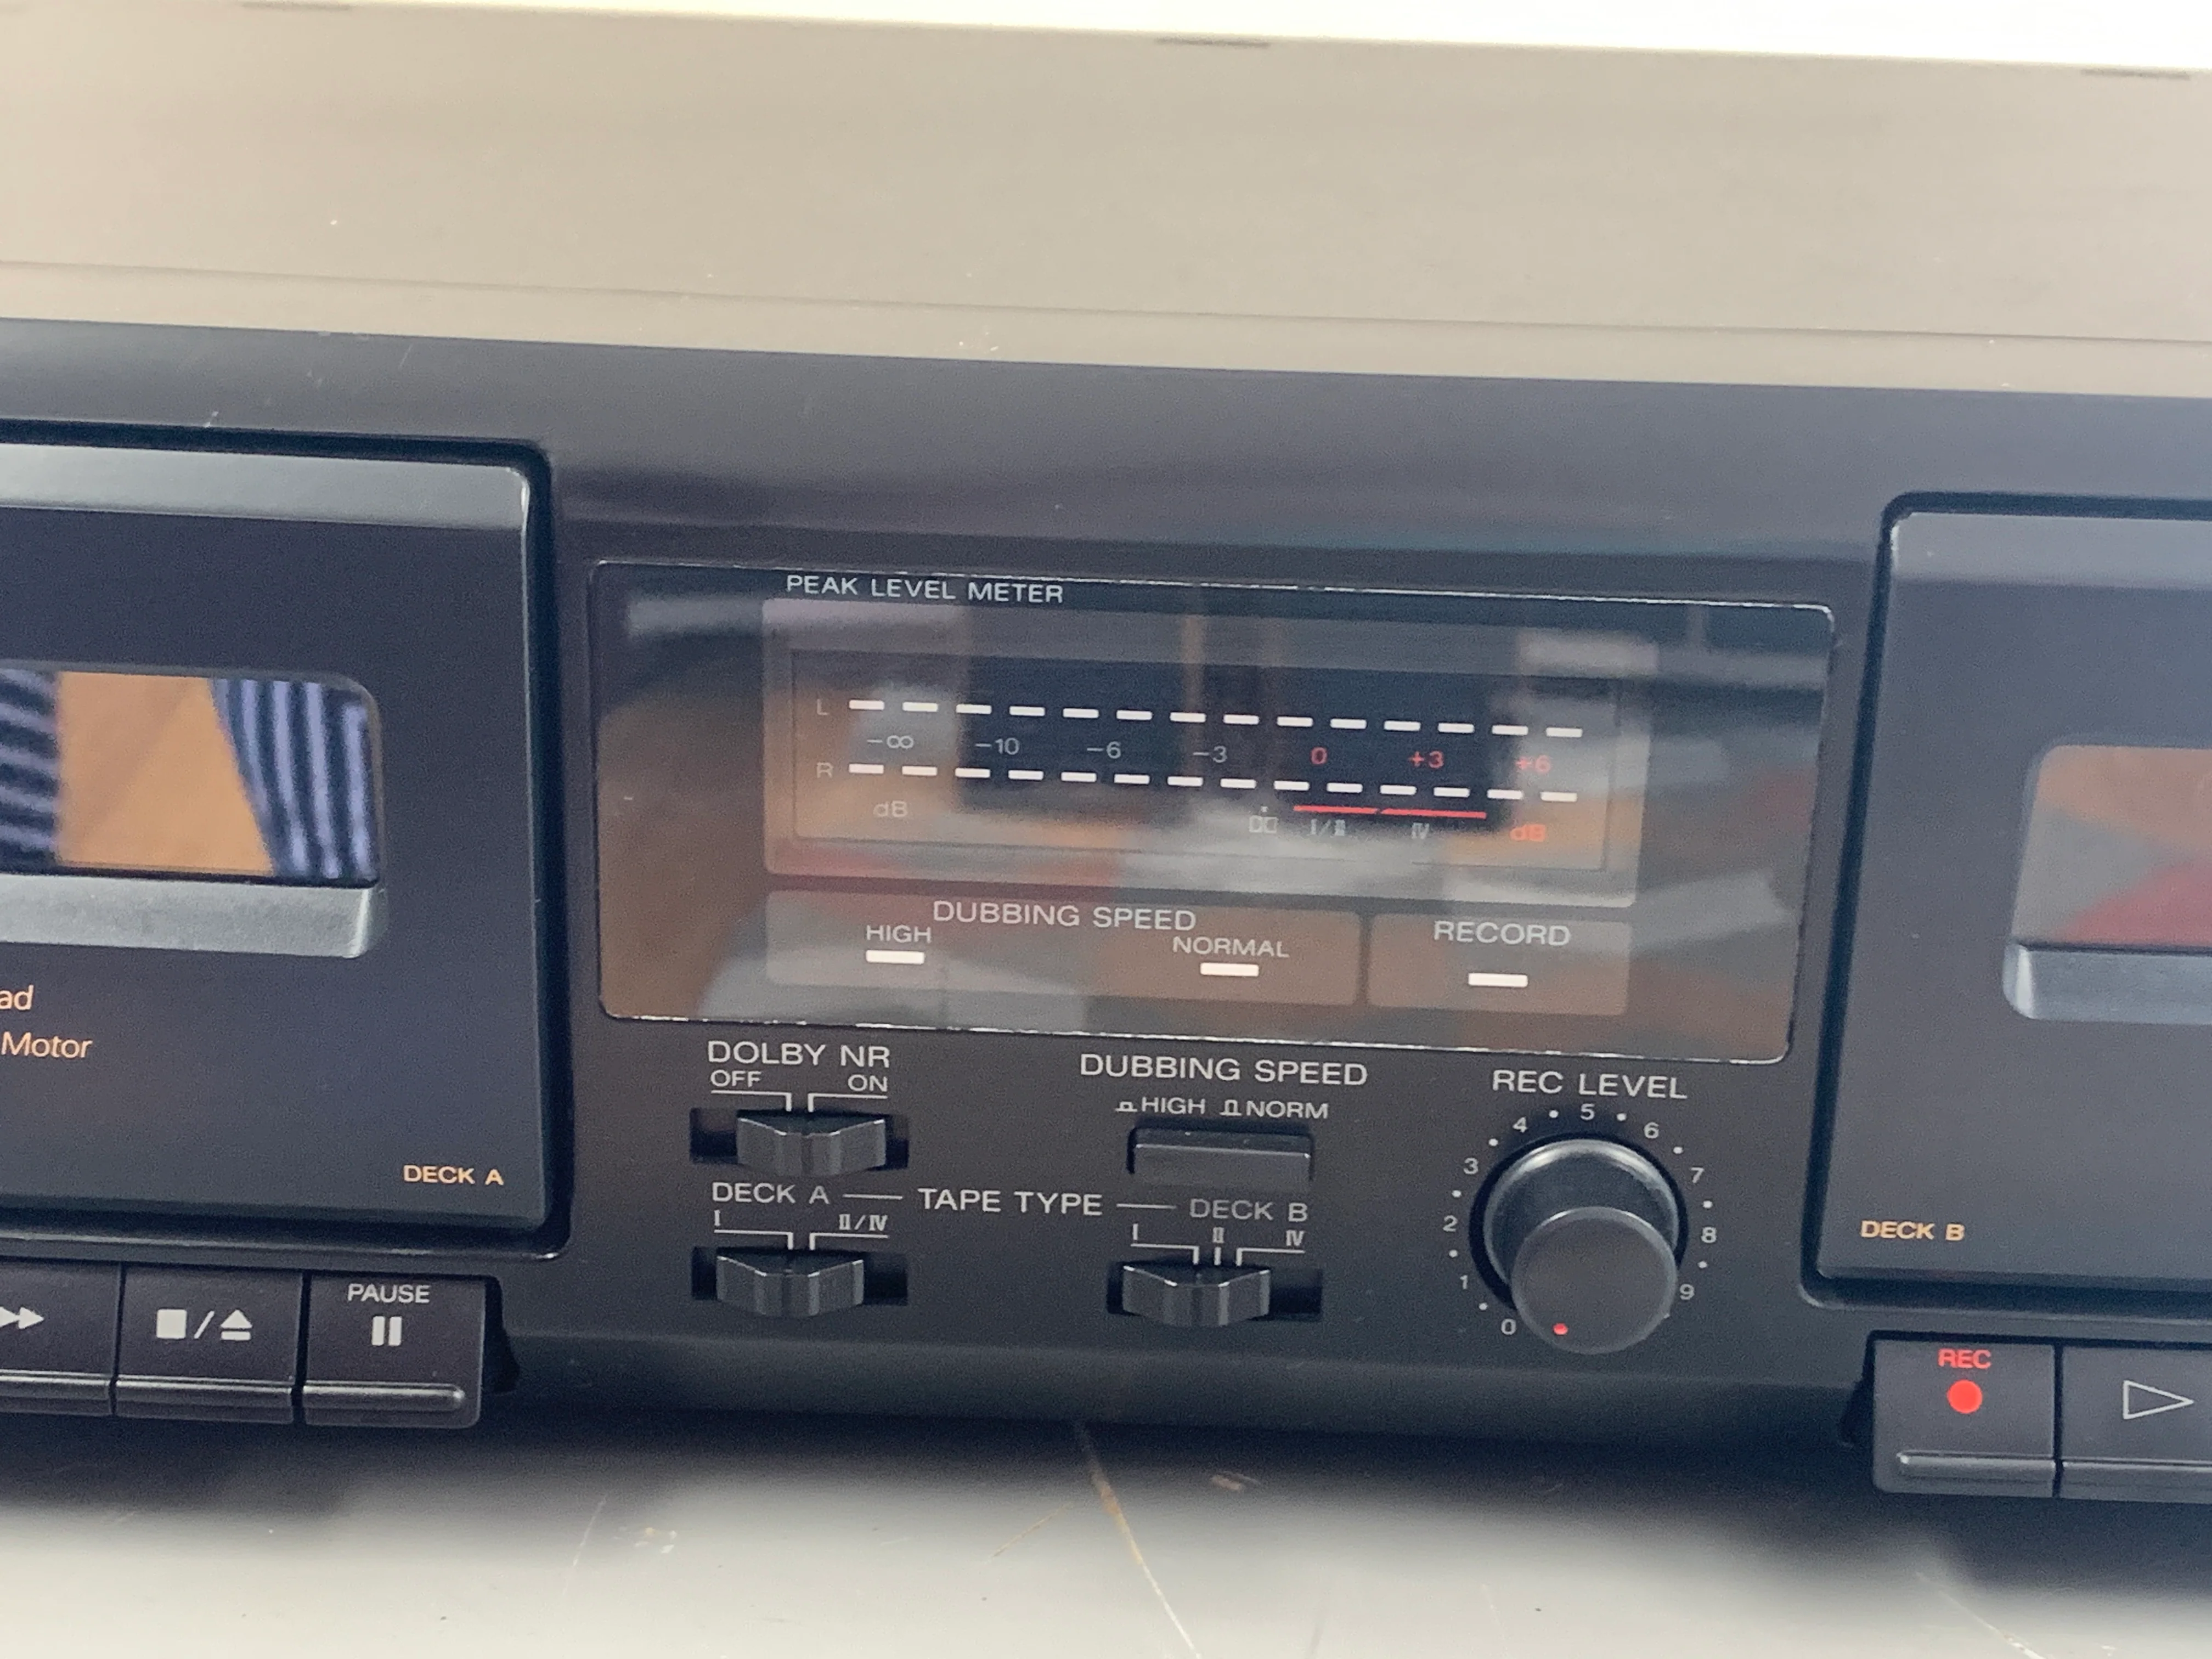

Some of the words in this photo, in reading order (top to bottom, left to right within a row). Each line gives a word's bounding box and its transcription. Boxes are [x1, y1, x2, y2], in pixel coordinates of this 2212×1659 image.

[786, 574, 858, 596] PEAK
[871, 579, 956, 600] LEVEL
[968, 582, 1064, 603] METER
[816, 699, 829, 716] L
[975, 737, 1021, 755] -10
[1087, 741, 1122, 759] -6
[1193, 746, 1228, 764] -3
[1311, 747, 1328, 764] 0
[1410, 751, 1444, 769] +3
[1515, 755, 1552, 774] +6
[816, 763, 833, 778] R
[873, 801, 909, 819] dB
[1510, 824, 1546, 842] dB
[933, 900, 1080, 927] DUBBING
[1092, 907, 1197, 931] SPEED
[866, 924, 932, 943] HIGH
[1434, 921, 1572, 946] RECORD
[1172, 936, 1290, 958] NORMAL
[1, 1031, 93, 1059] Motor
[707, 1040, 826, 1065] DOLBY
[840, 1045, 890, 1068] NR
[710, 1069, 762, 1087] OFF
[1080, 1053, 1240, 1081] DUBBING
[1254, 1059, 1368, 1086] SPEED
[847, 1074, 888, 1092] ON
[1492, 1070, 1564, 1094] REC
[1578, 1073, 1688, 1099] LEVEL
[1141, 1097, 1206, 1115] HIGH
[1246, 1101, 1328, 1120] NORM
[1580, 1104, 1595, 1120] 5
[1513, 1117, 1527, 1133] 4
[1644, 1122, 1659, 1139] 6
[403, 1164, 475, 1185] DECK
[484, 1168, 505, 1186] A
[1463, 1158, 1479, 1175] 3
[1690, 1167, 1704, 1183] 7
[713, 1182, 795, 1204] DECK
[809, 1186, 830, 1204] A
[917, 1188, 1001, 1212] TAPE
[1014, 1192, 1103, 1216] TYPE
[1189, 1198, 1274, 1221] DECK
[1288, 1202, 1308, 1222] B
[1443, 1215, 1458, 1232] 2
[1860, 1220, 1934, 1240] DECK
[1946, 1223, 1965, 1242] B
[1701, 1226, 1717, 1244] 8
[1459, 1275, 1468, 1290] 1
[347, 1283, 431, 1304] PAUSE
[1679, 1284, 1695, 1300] 9
[1500, 1319, 1516, 1335] 0
[1938, 1348, 1991, 1369] REC
